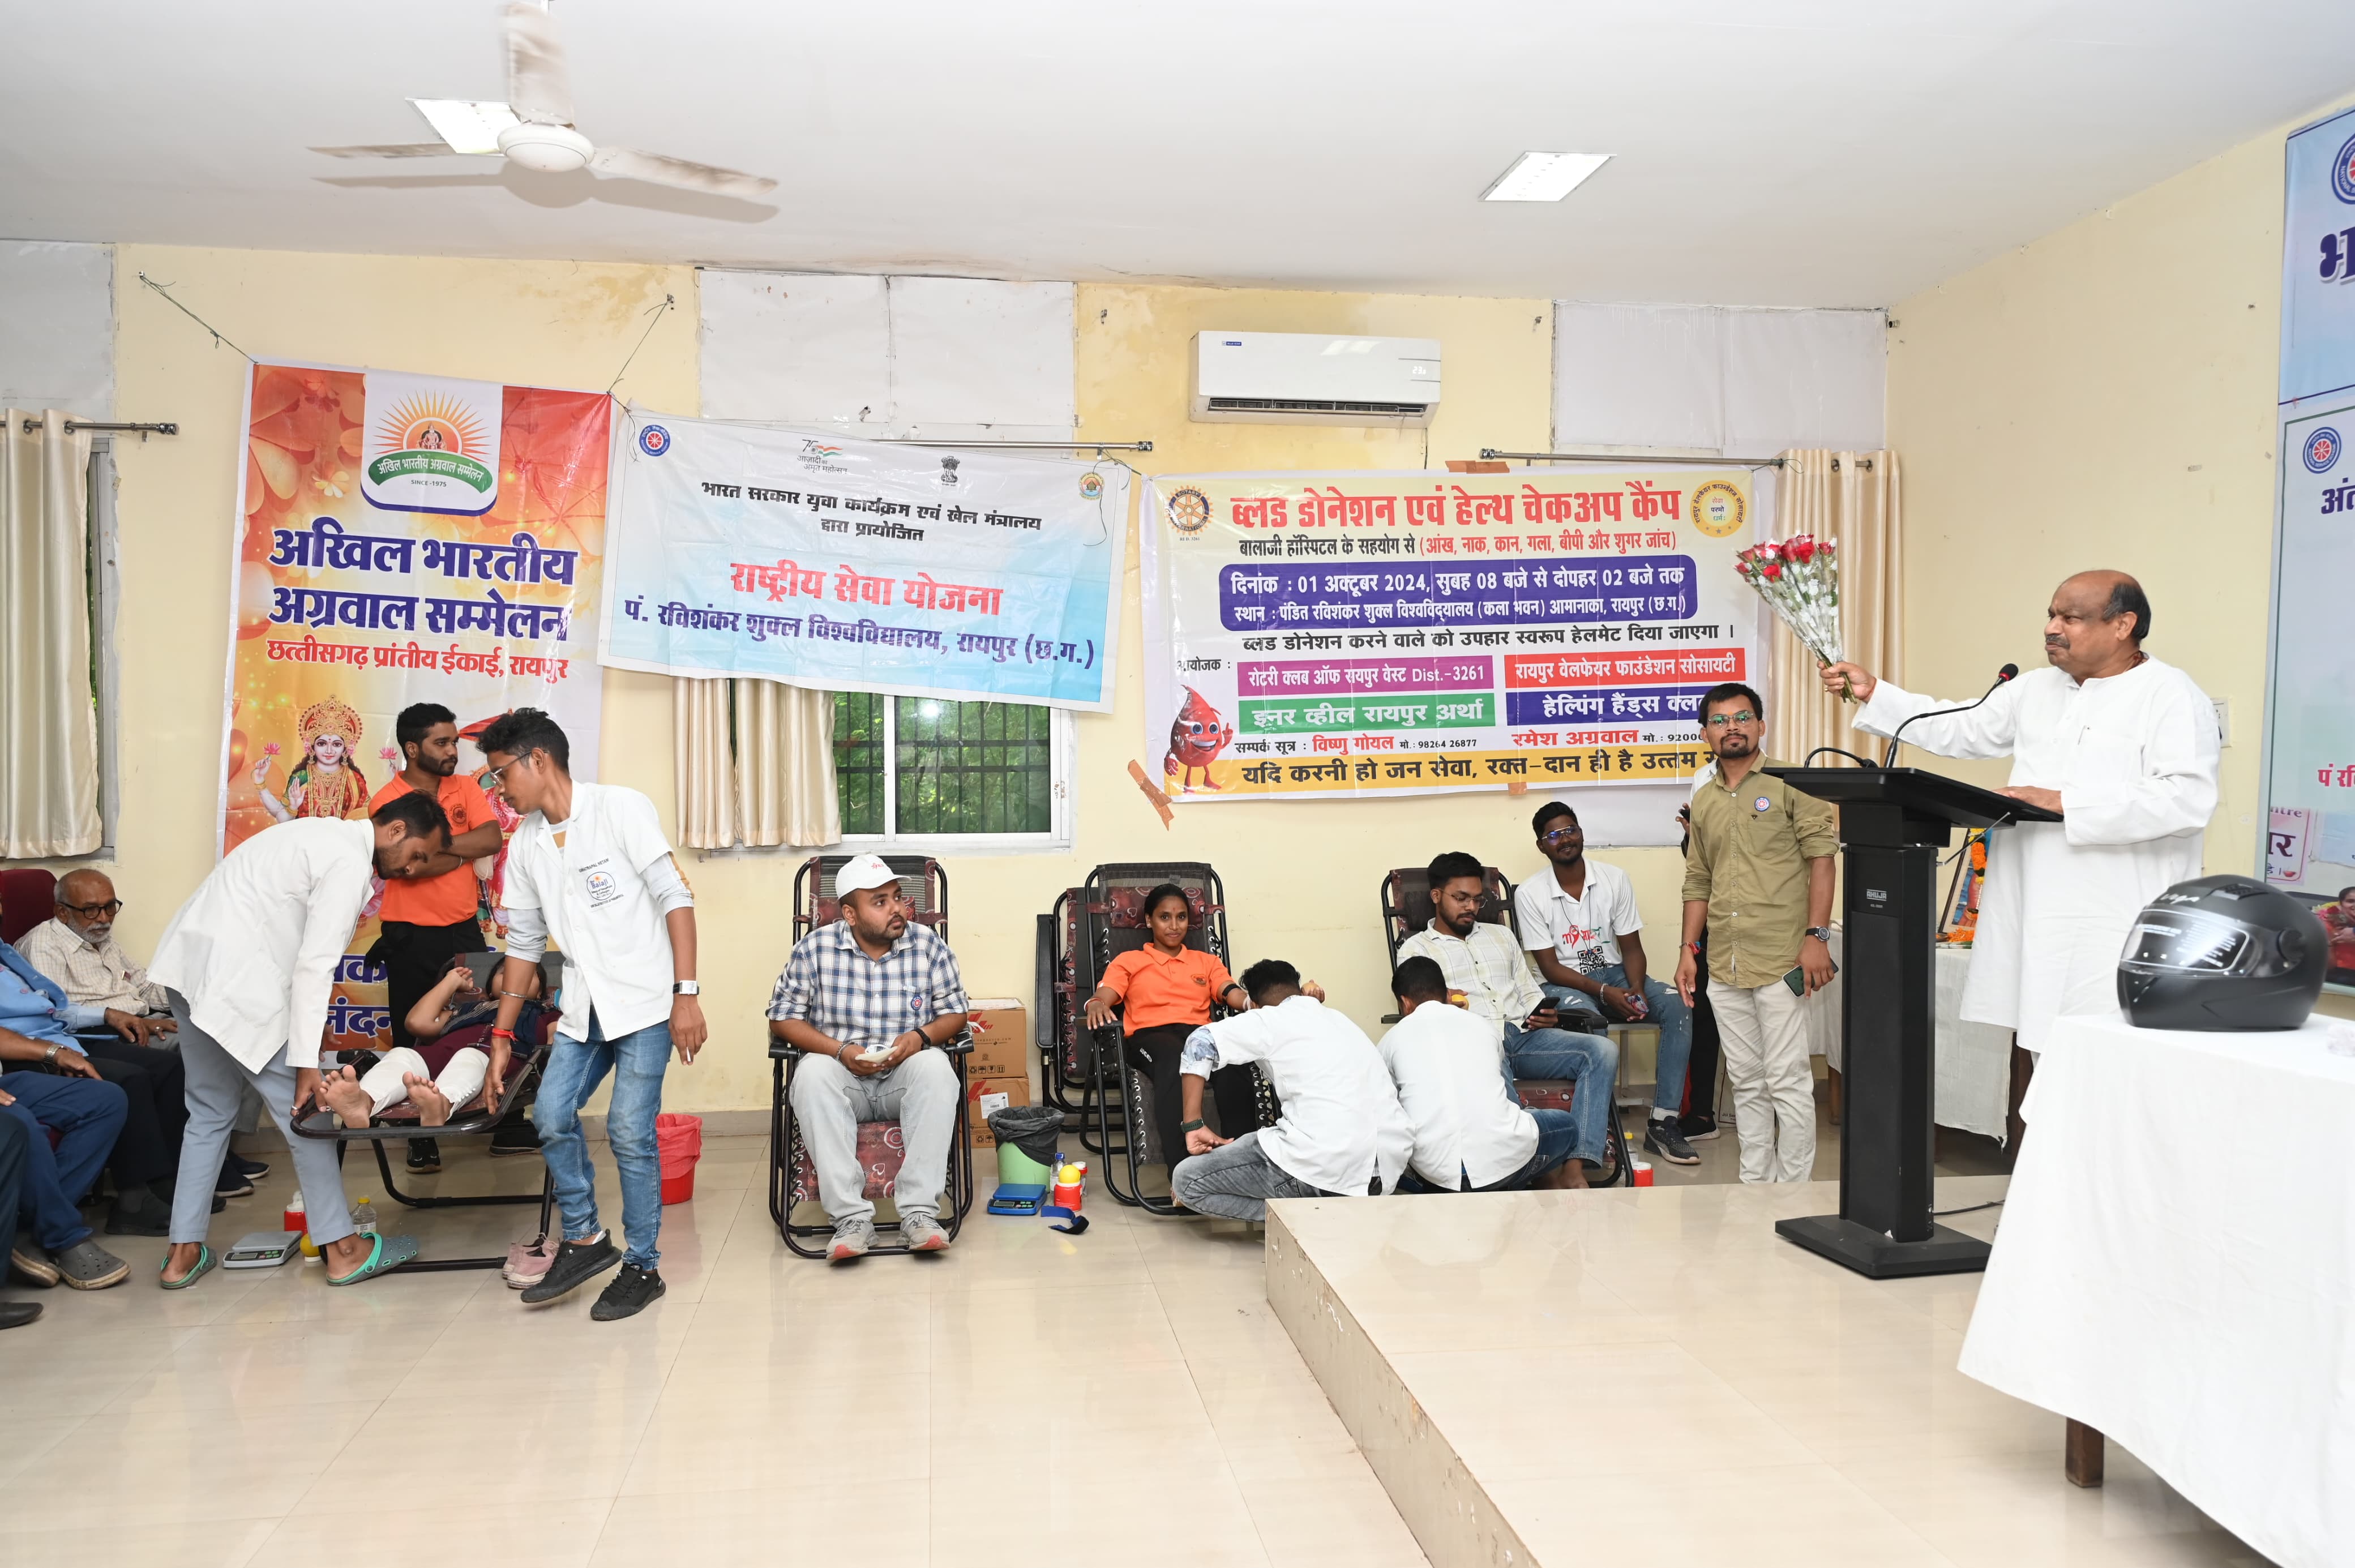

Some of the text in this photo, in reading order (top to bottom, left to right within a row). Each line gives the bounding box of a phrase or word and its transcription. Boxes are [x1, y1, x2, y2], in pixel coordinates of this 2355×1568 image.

[377, 455, 484, 482] अखिल भारतीय अग्रवाल सम्मेलन
[804, 464, 820, 473] अमृत
[701, 482, 1042, 530] भारत सरकार युवा कार्यक्रम एवं खेल मंत्रालय
[1230, 481, 1681, 528] ब्लड डोनेशन एवं हेल्थ चेकअप कैंप
[821, 519, 924, 541] द्वारा प्रायोजित
[1239, 534, 1282, 556] बालाजी
[1287, 534, 1337, 556] हॉस्पिटल
[1342, 534, 1353, 555] के
[1359, 535, 1399, 555] सहयोग
[1404, 534, 1415, 554] से
[1559, 529, 1584, 551] बीपी
[1588, 529, 1610, 550] और
[1615, 532, 1642, 554] शुगर
[269, 516, 578, 585] अखिल भारतीय
[730, 559, 1004, 616] राष्ट्रीय सेवा योजना
[1231, 563, 1685, 597] दिनांक 01 अक्टूबर 2024, सुबह 08 बजे से दोपहर 02 बजे तक
[269, 587, 572, 641] अग्रवाल सम्मेलन
[1234, 605, 1265, 622] स्थान
[1279, 601, 1309, 621] पंडित
[1312, 601, 1360, 620] रविशंकर
[1364, 603, 1393, 623] शुक्ल
[1611, 597, 1645, 617] रायपुर
[624, 595, 1094, 670] पं. रविशंकर शुक्ल विश्वविद्यालय, रायपुर (छ.ग.)
[1242, 635, 1277, 651] ब्लड
[1283, 632, 1342, 650] डोनेशन
[1348, 630, 1386, 649] करने
[1394, 629, 1425, 647] वाले
[1432, 628, 1454, 647] को
[1460, 629, 1509, 647] उपहार
[1515, 628, 1565, 645] स्वरूप
[1571, 624, 1621, 644] हेलमेट
[1628, 624, 1663, 641] दिया
[1669, 624, 1719, 640] जाएगा
[267, 635, 369, 670] छत्तीसगढ़
[374, 641, 438, 670] प्रांतीय
[509, 655, 568, 684] रायपुर
[1515, 652, 1736, 684] रायपुर वेलफेयर फाउंडेशन सोसायटी
[1248, 665, 1278, 687] रोटरी
[1282, 670, 1309, 686] क्लब
[1313, 665, 1341, 684] ऑफ
[1382, 663, 1406, 683] वेस्ट
[1252, 708, 1295, 727] इनर
[1304, 702, 1354, 726] व्हील
[1362, 704, 1427, 729] रायपुर
[1543, 691, 1705, 719] हेल्पिंग हैंड्स क्ल
[1235, 739, 1270, 753] सम्पर्क
[1275, 740, 1296, 755] सूत्र
[1312, 734, 1349, 755] विष्णु
[1354, 733, 1394, 751] गोयल
[1449, 739, 1477, 748] 26877
[1512, 729, 1558, 747] रमेश
[1566, 729, 1639, 745] अग्रवाल
[1242, 761, 1282, 785] यदि
[1289, 758, 1347, 782] करनी
[1355, 757, 1377, 781] हो
[1384, 760, 1421, 778] जन
[1429, 756, 1477, 779] सेवा,
[1589, 749, 1610, 772] ही
[1620, 749, 1633, 770] है
[1641, 752, 1697, 770] उत्तम
[1866, 890, 1887, 899] AHUJA
